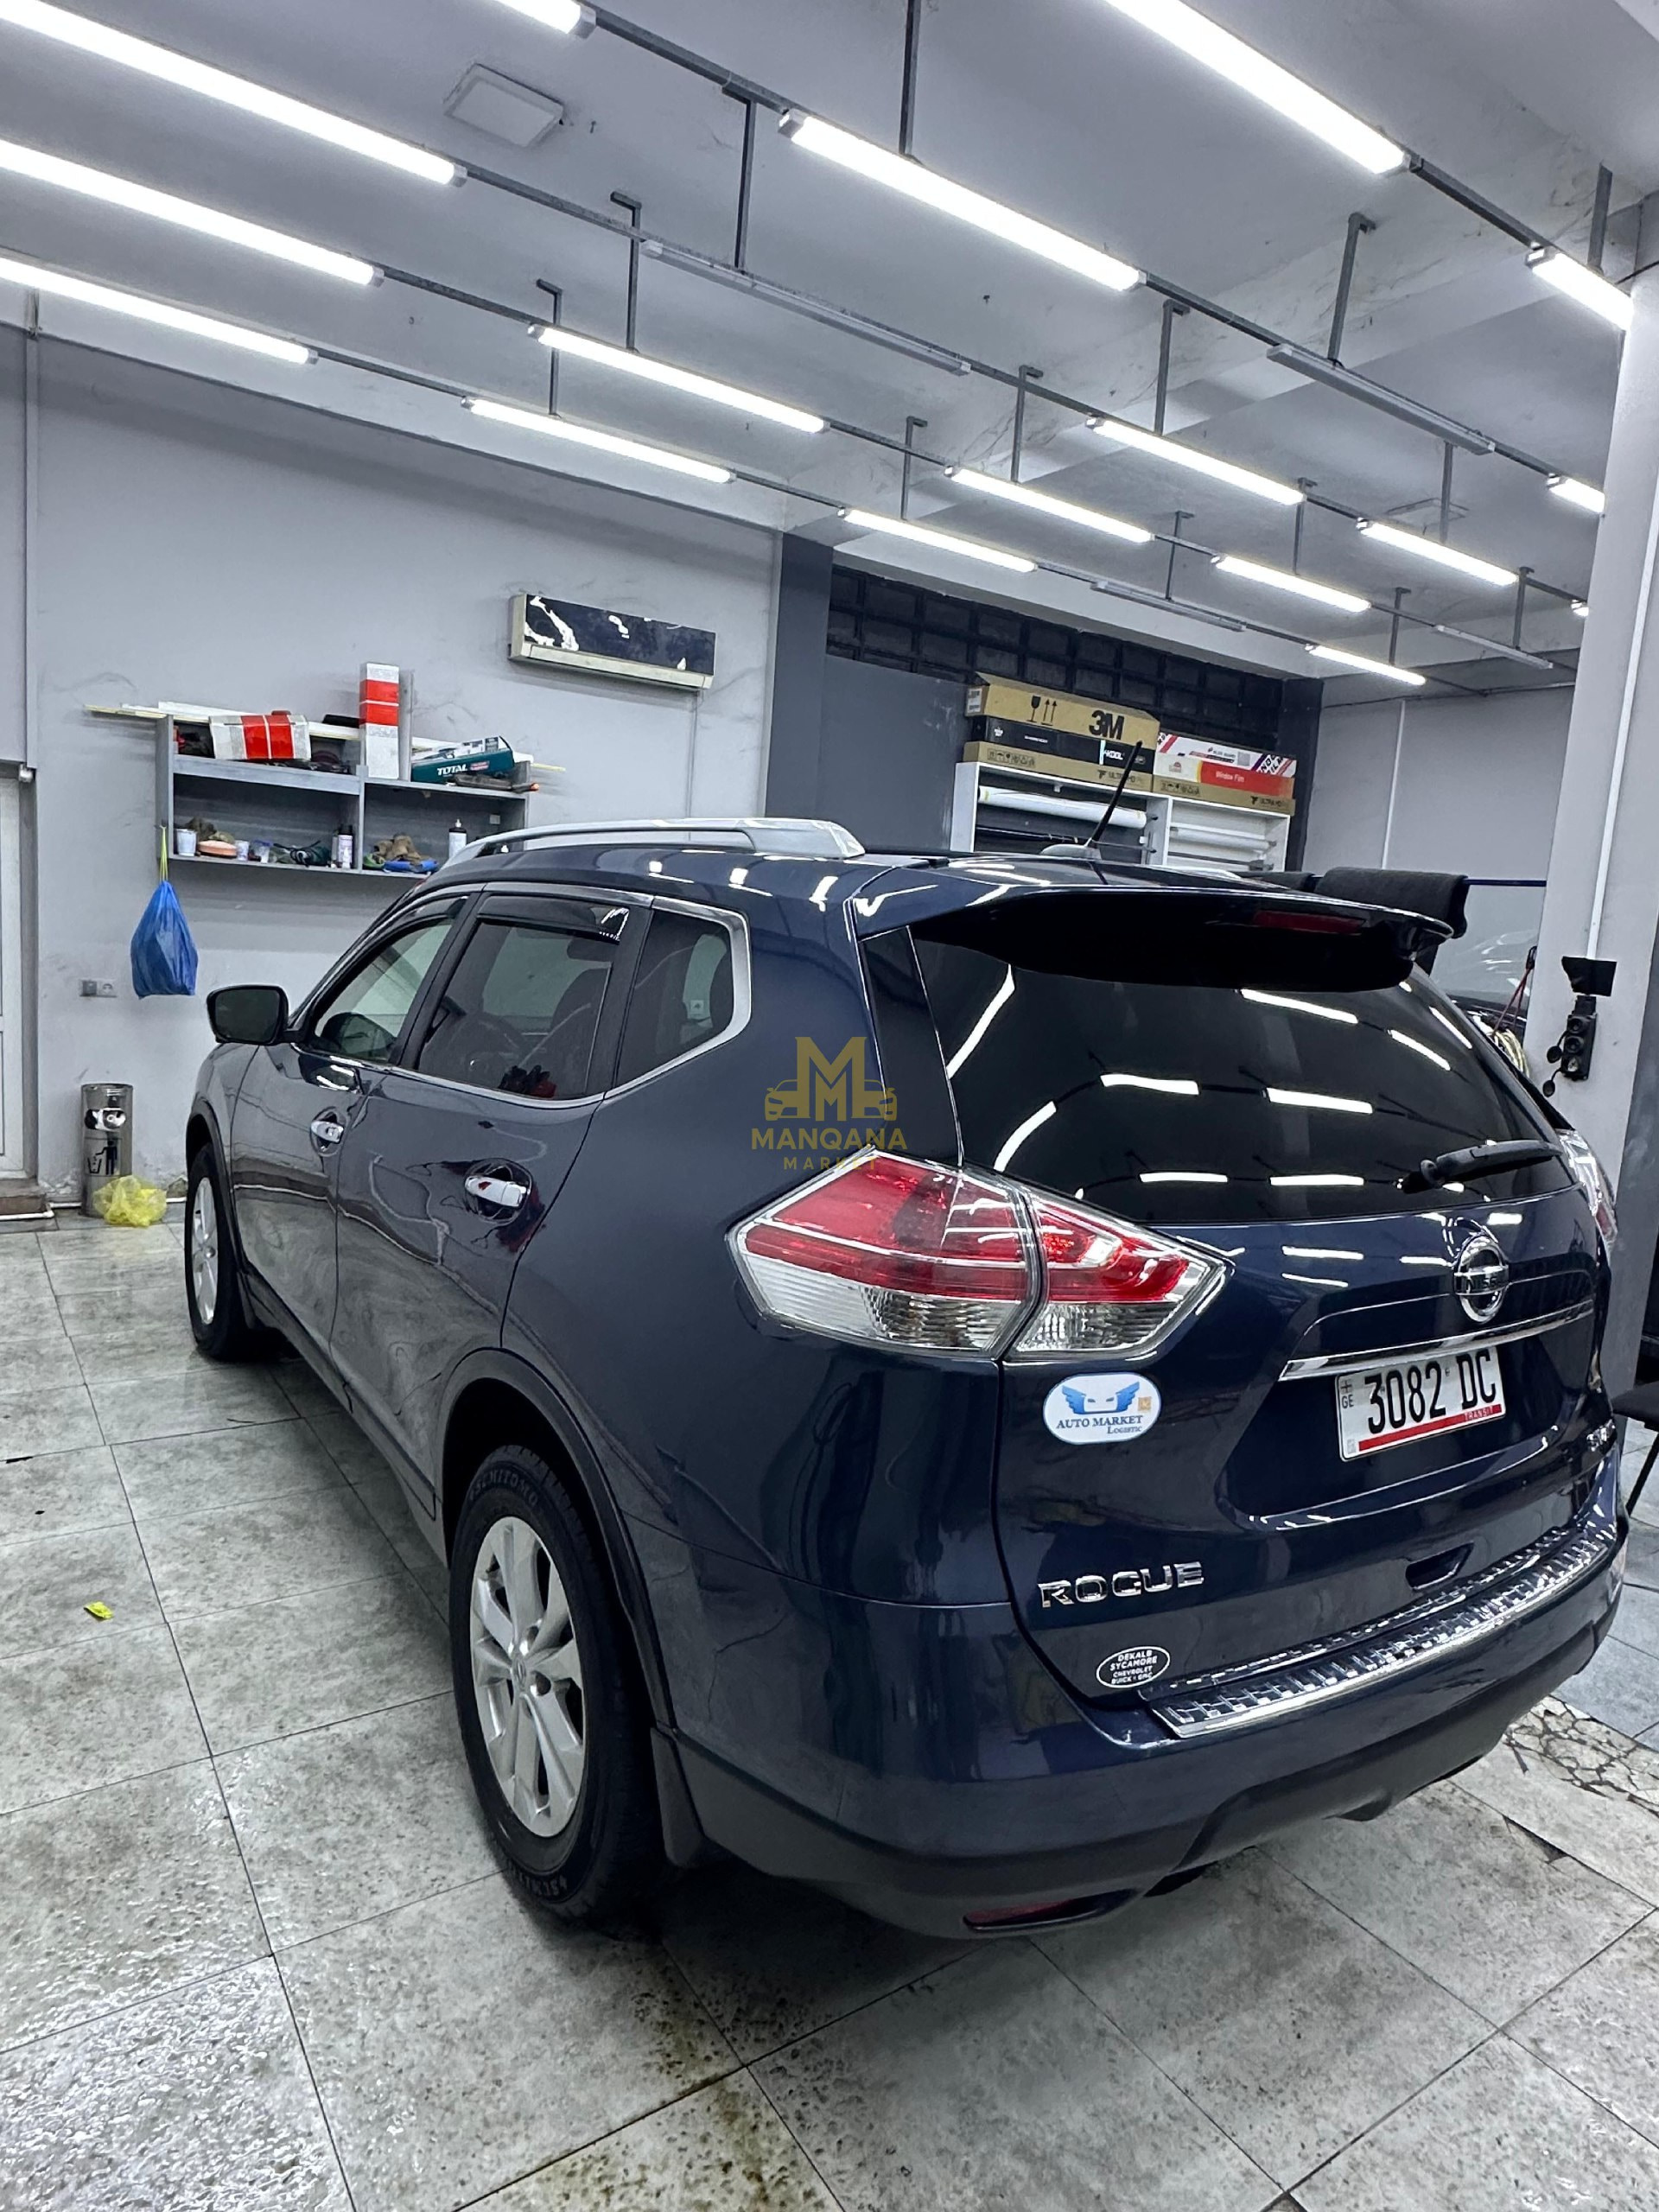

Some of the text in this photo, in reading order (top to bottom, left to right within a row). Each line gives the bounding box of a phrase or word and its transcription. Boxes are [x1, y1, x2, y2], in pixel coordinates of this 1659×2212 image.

[1089, 709, 1125, 741] 3M
[437, 764, 467, 776] TOTAL
[1364, 1349, 1496, 1434] 3082 DC
[1342, 1393, 1354, 1408] GE
[1464, 1406, 1494, 1422] TRANSIT
[1056, 1415, 1143, 1429] AUTO MARKET
[1037, 1560, 1205, 1608] ROGUE
[1117, 1649, 1153, 1662] DEKALB
[1109, 1656, 1158, 1671] SYCAMORE
[1112, 1665, 1153, 1678] CHEVROLET
